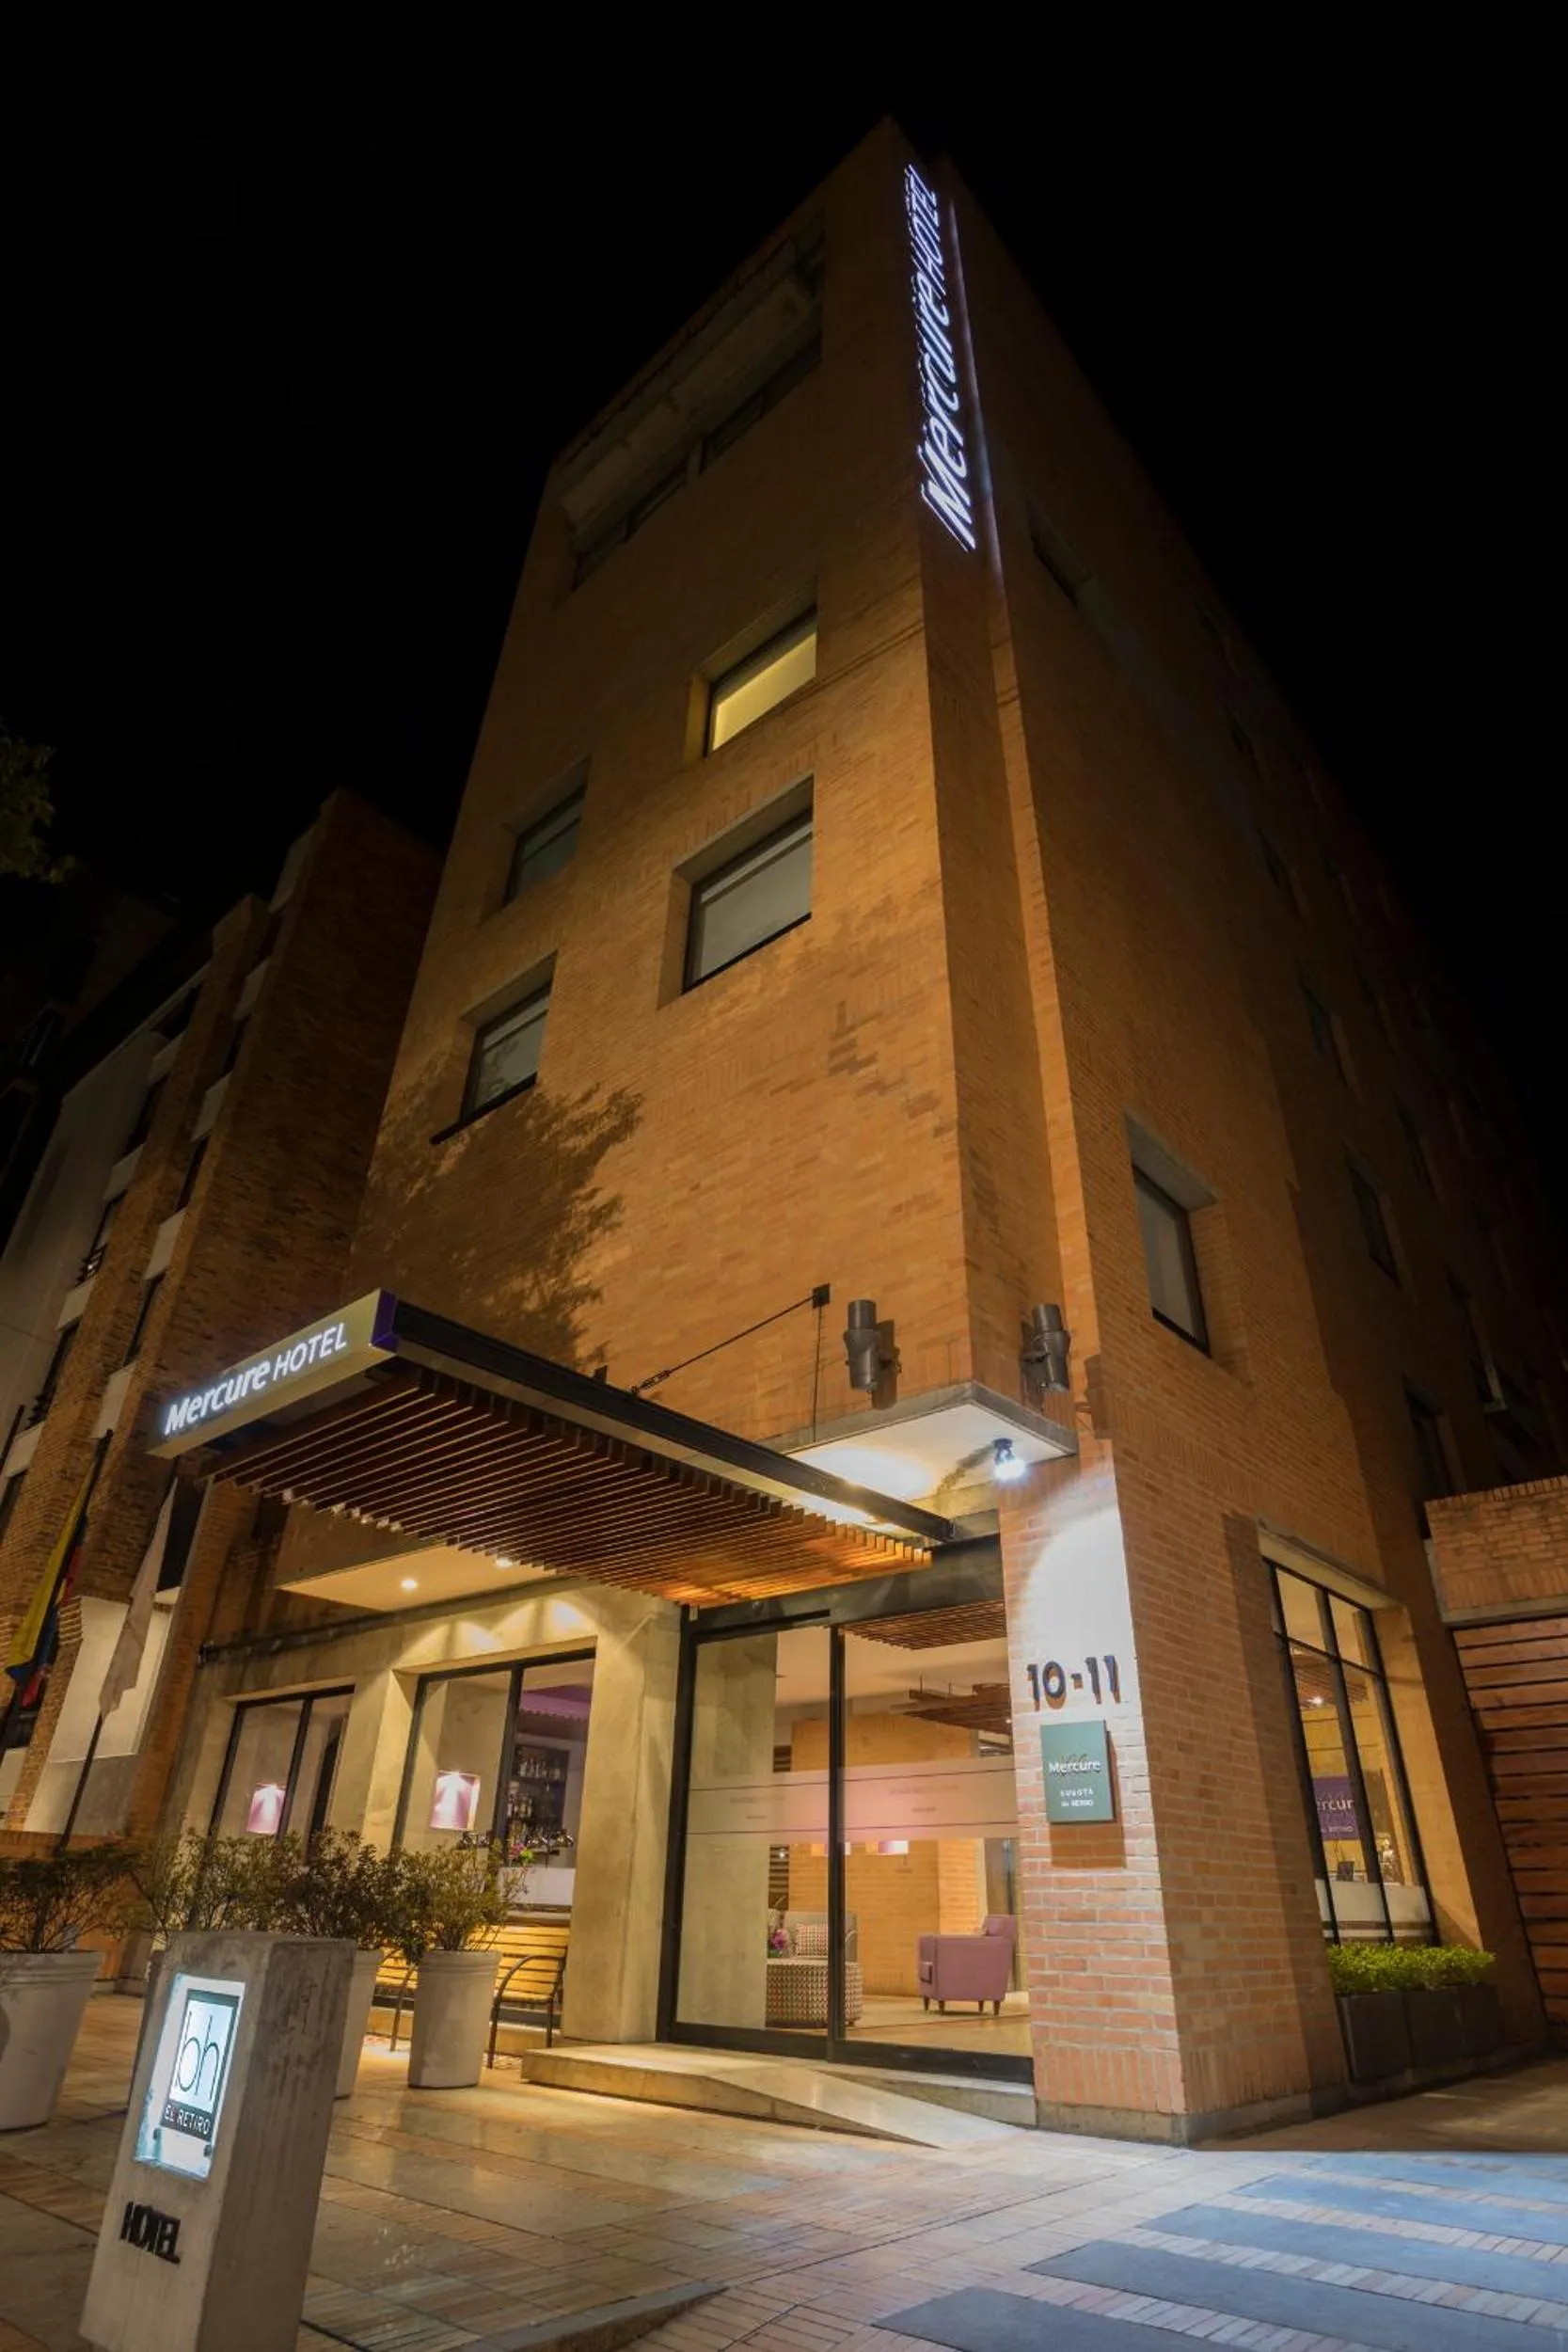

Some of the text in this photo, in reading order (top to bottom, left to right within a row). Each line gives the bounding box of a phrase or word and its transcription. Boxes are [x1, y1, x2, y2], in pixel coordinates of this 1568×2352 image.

[907, 164, 976, 550] Mercure HOTEL
[163, 1322, 348, 1436] Mercure HOTEL
[1026, 1654, 1121, 1712] 10-11
[1048, 1760, 1102, 1774] Mercure
[1316, 1798, 1355, 1811] ercur
[176, 2109, 211, 2136] RETIRO
